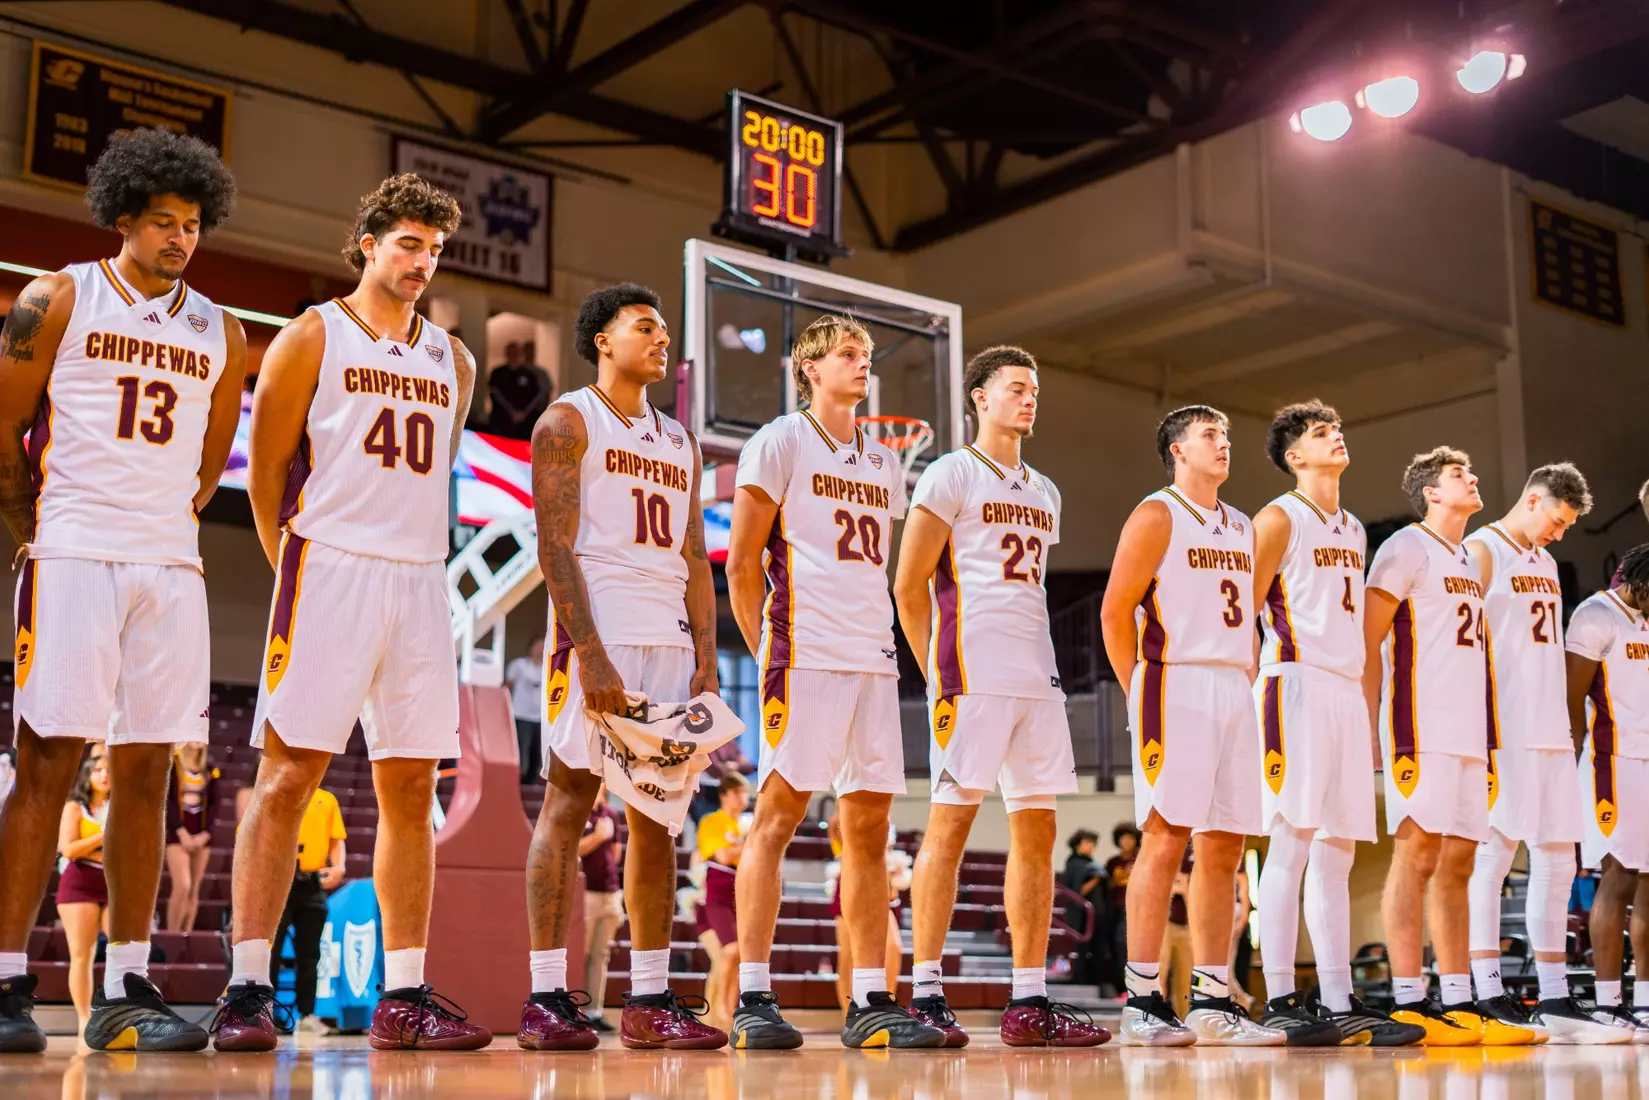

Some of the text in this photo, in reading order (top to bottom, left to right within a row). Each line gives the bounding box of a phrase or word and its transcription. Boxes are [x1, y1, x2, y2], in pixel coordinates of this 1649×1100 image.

[742, 110, 825, 167] 20:00
[752, 152, 817, 229] 30
[86, 331, 211, 381] CHIPPEWAS
[116, 375, 178, 446] 13
[344, 367, 450, 409] CHIPPEWAS
[364, 405, 434, 476] 40
[605, 447, 688, 493] CHIPPEWAS
[812, 472, 889, 511] CHIPPEWAS
[631, 487, 673, 549] 10
[834, 508, 884, 567] 20
[982, 502, 1054, 534] CHIPPEWAS
[1001, 531, 1043, 586] 23
[1187, 547, 1252, 575] CHIPPEWAS
[1220, 578, 1244, 628] 3
[1341, 575, 1356, 617] 4
[1456, 602, 1484, 651] 24
[1530, 600, 1558, 645] 21
